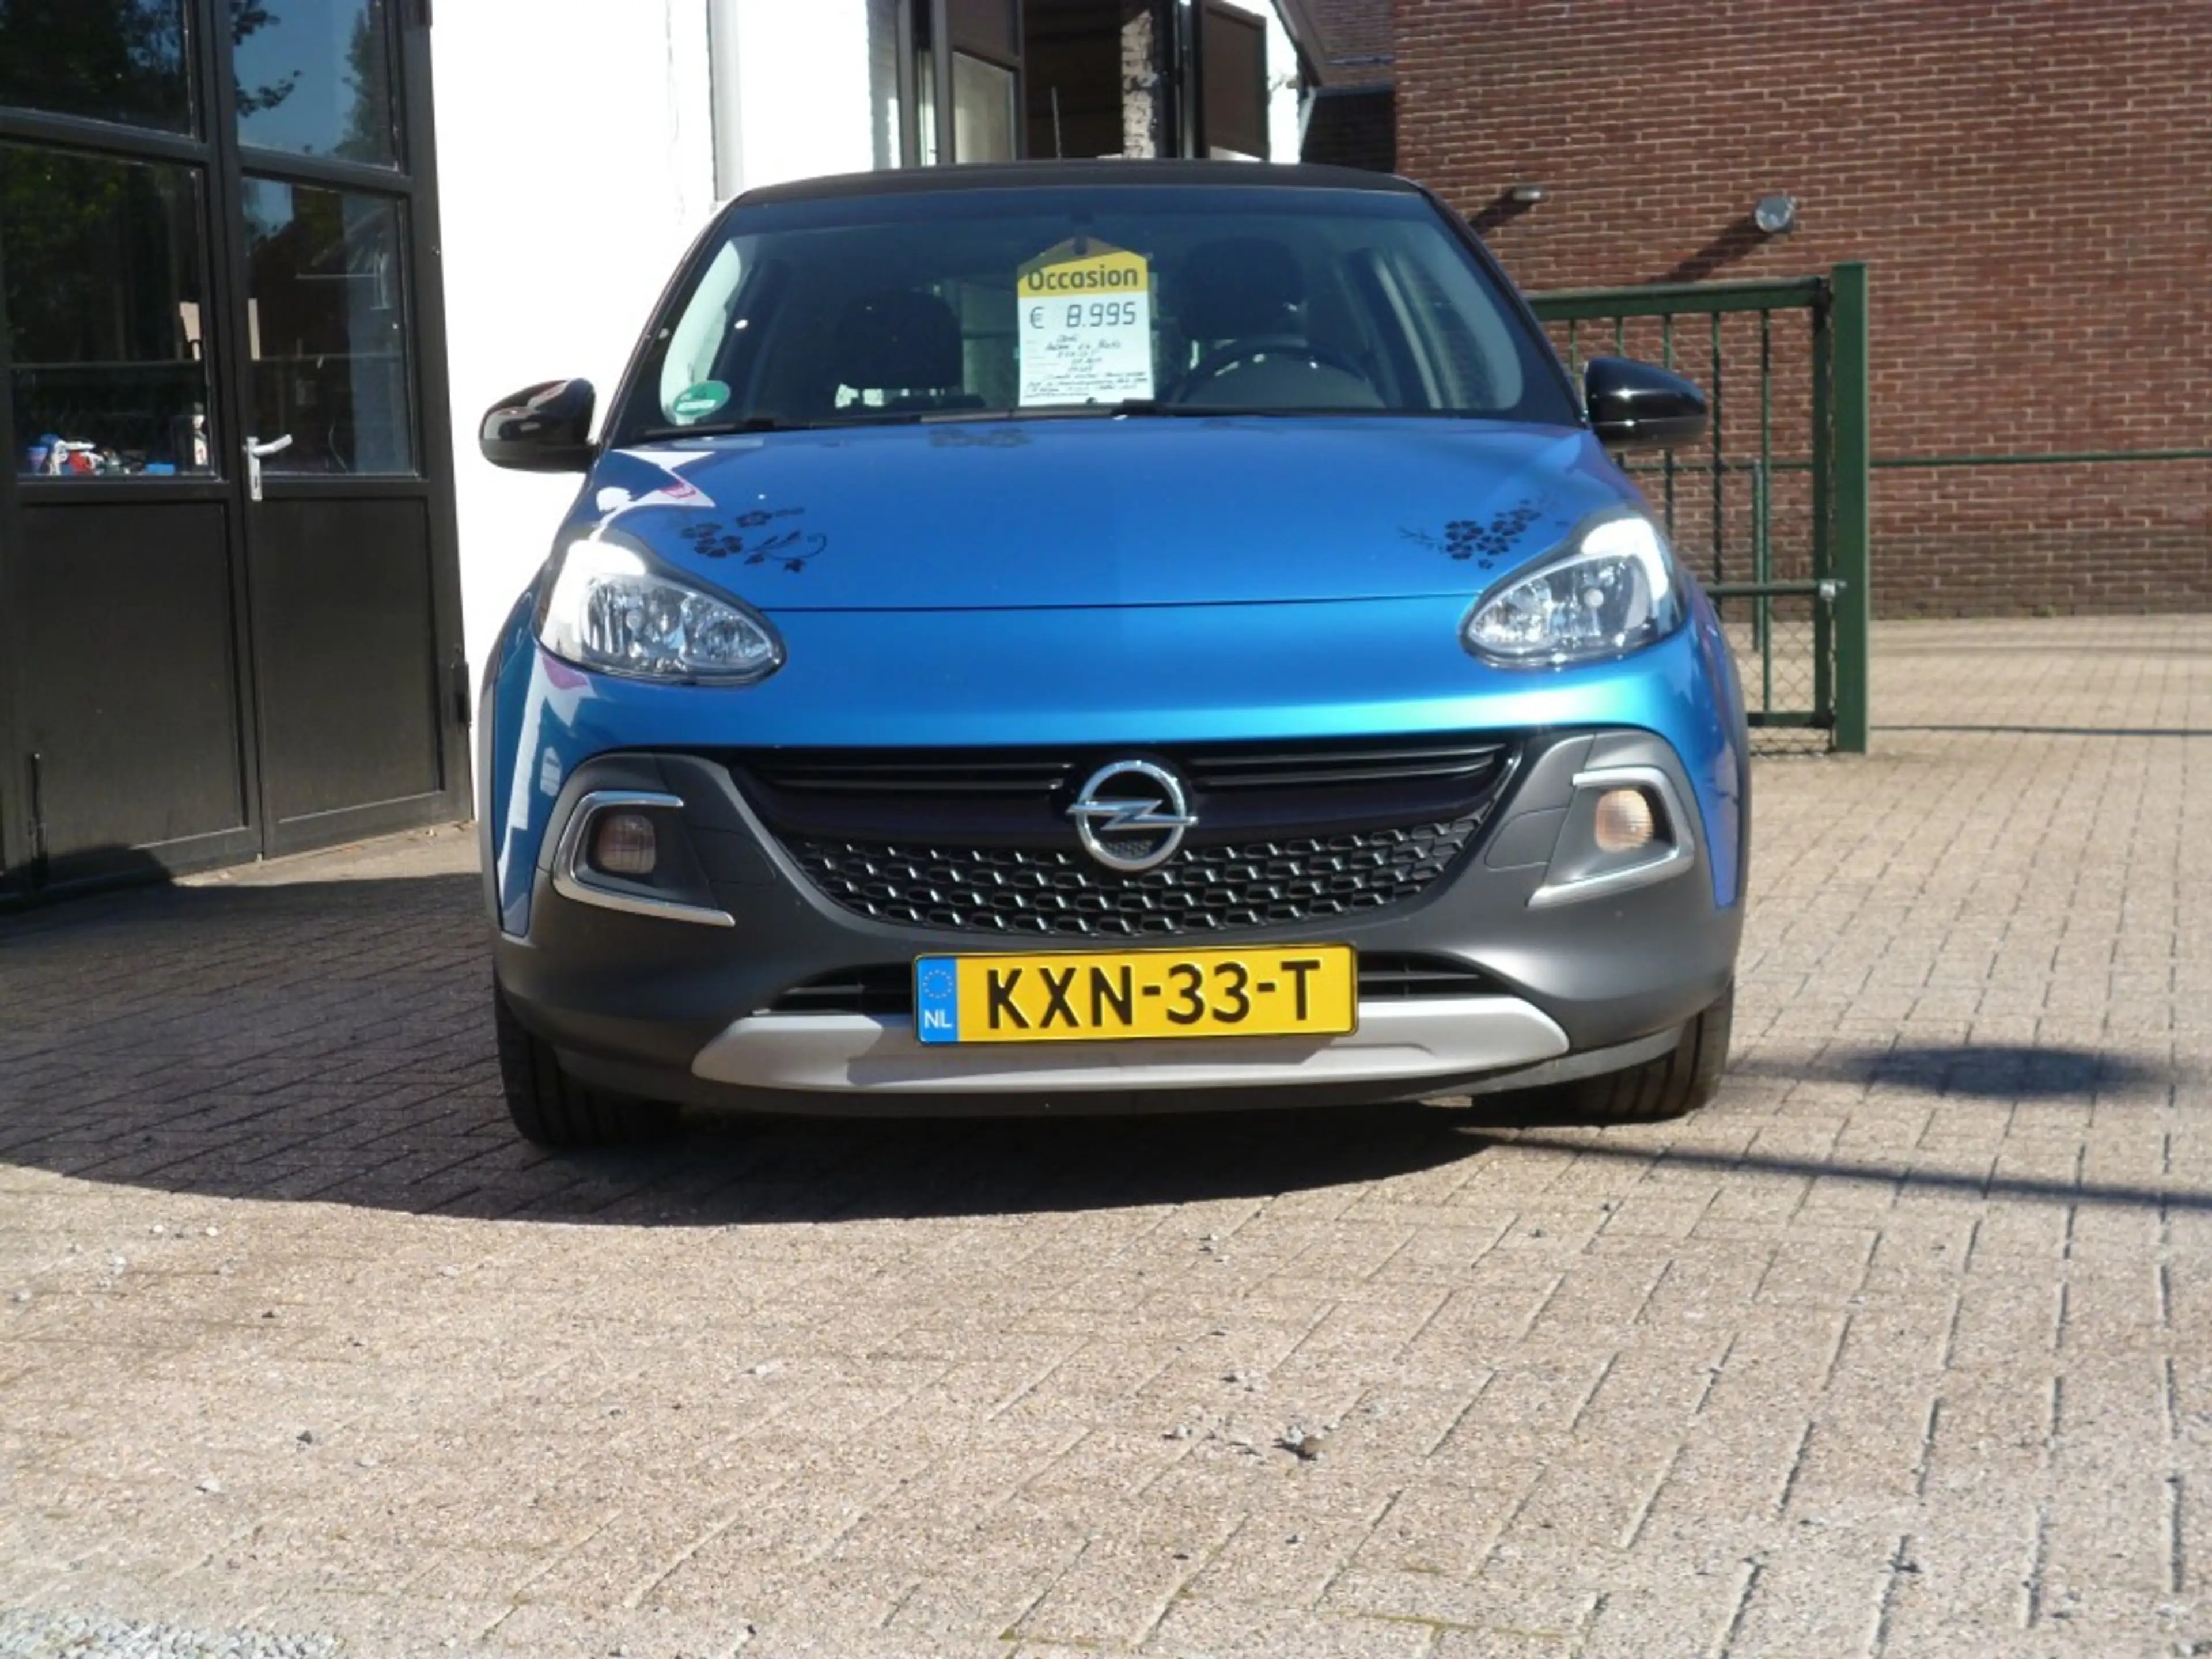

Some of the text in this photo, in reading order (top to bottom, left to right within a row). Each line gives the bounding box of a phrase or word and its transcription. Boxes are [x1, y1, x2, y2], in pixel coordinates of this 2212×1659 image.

[1028, 264, 1139, 290] Occasion
[1030, 301, 1135, 329] € 8.995
[988, 960, 1320, 1029] KXN-33-T
[924, 1009, 953, 1028] NL
